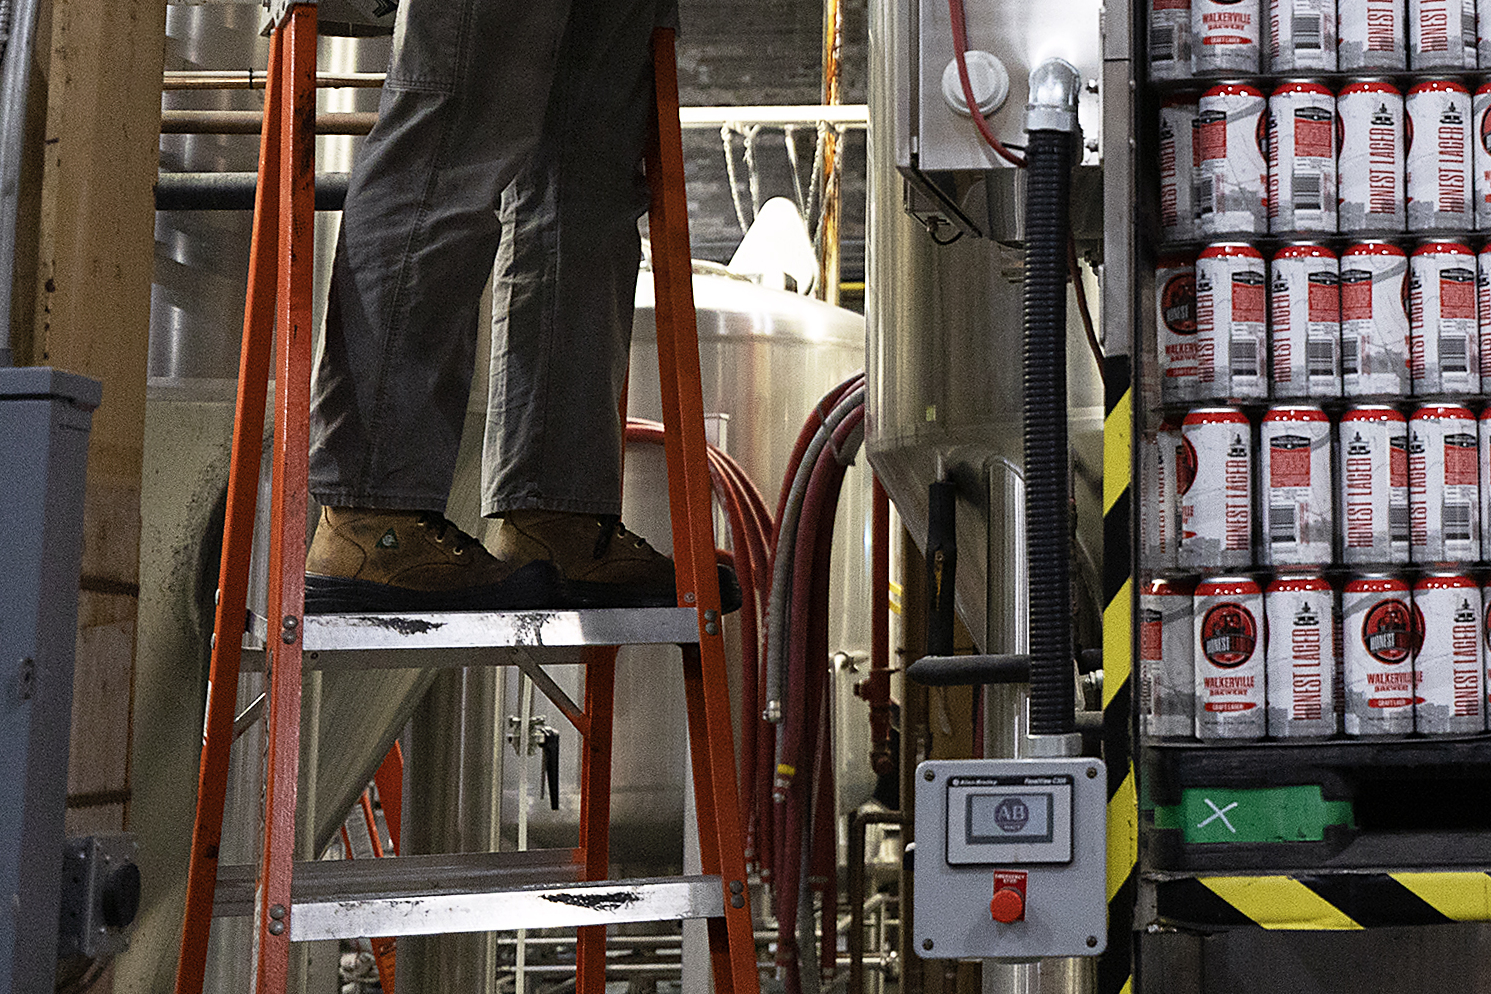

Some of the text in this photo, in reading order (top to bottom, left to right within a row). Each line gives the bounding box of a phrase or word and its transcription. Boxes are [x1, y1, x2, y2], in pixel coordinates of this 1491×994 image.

[1368, 8, 1394, 51] HONEST
[1420, 8, 1448, 52] HONEST
[1370, 128, 1395, 214] HONEST LAGER
[1438, 127, 1464, 212] HONEST LAGER
[1204, 676, 1254, 689] WALKERVILLE
[1292, 628, 1321, 719] HONEST LAGER
